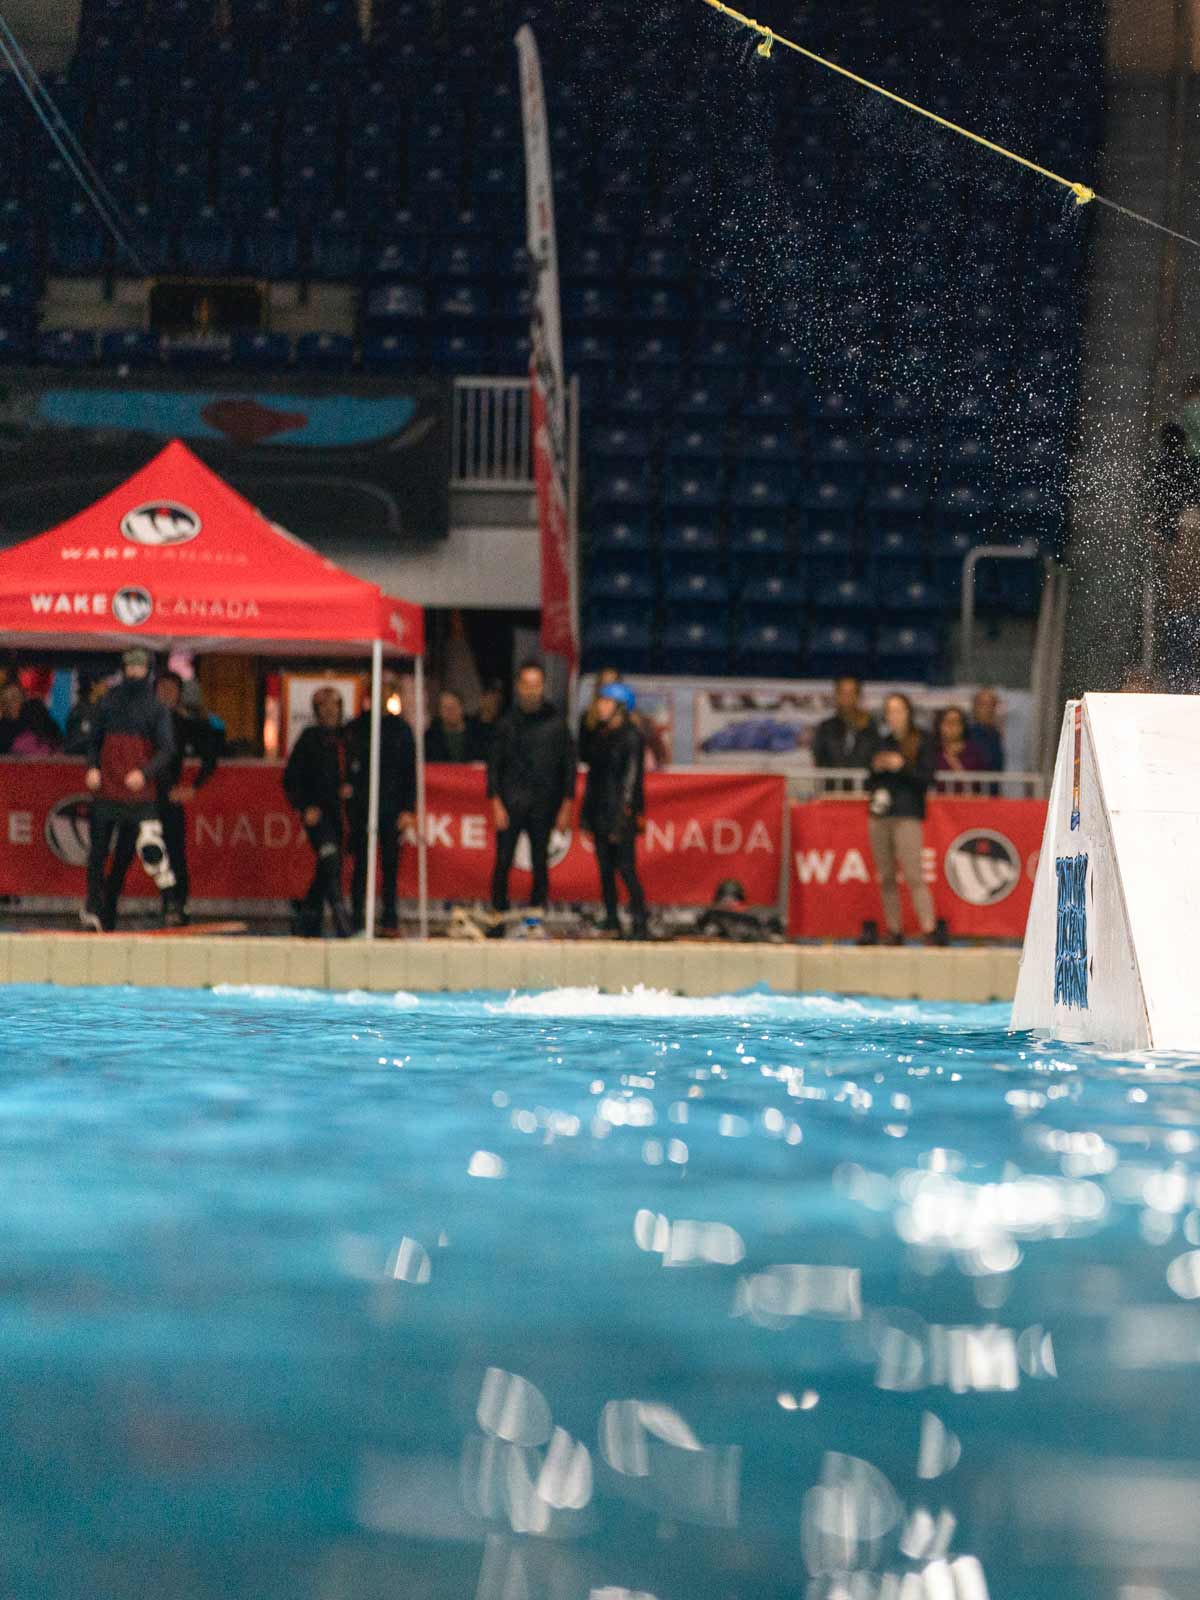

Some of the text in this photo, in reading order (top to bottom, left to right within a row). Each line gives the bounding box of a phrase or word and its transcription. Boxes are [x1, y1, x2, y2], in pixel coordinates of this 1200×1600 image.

[30, 593, 260, 620] WAKE CANADA
[795, 848, 938, 885] WAE
